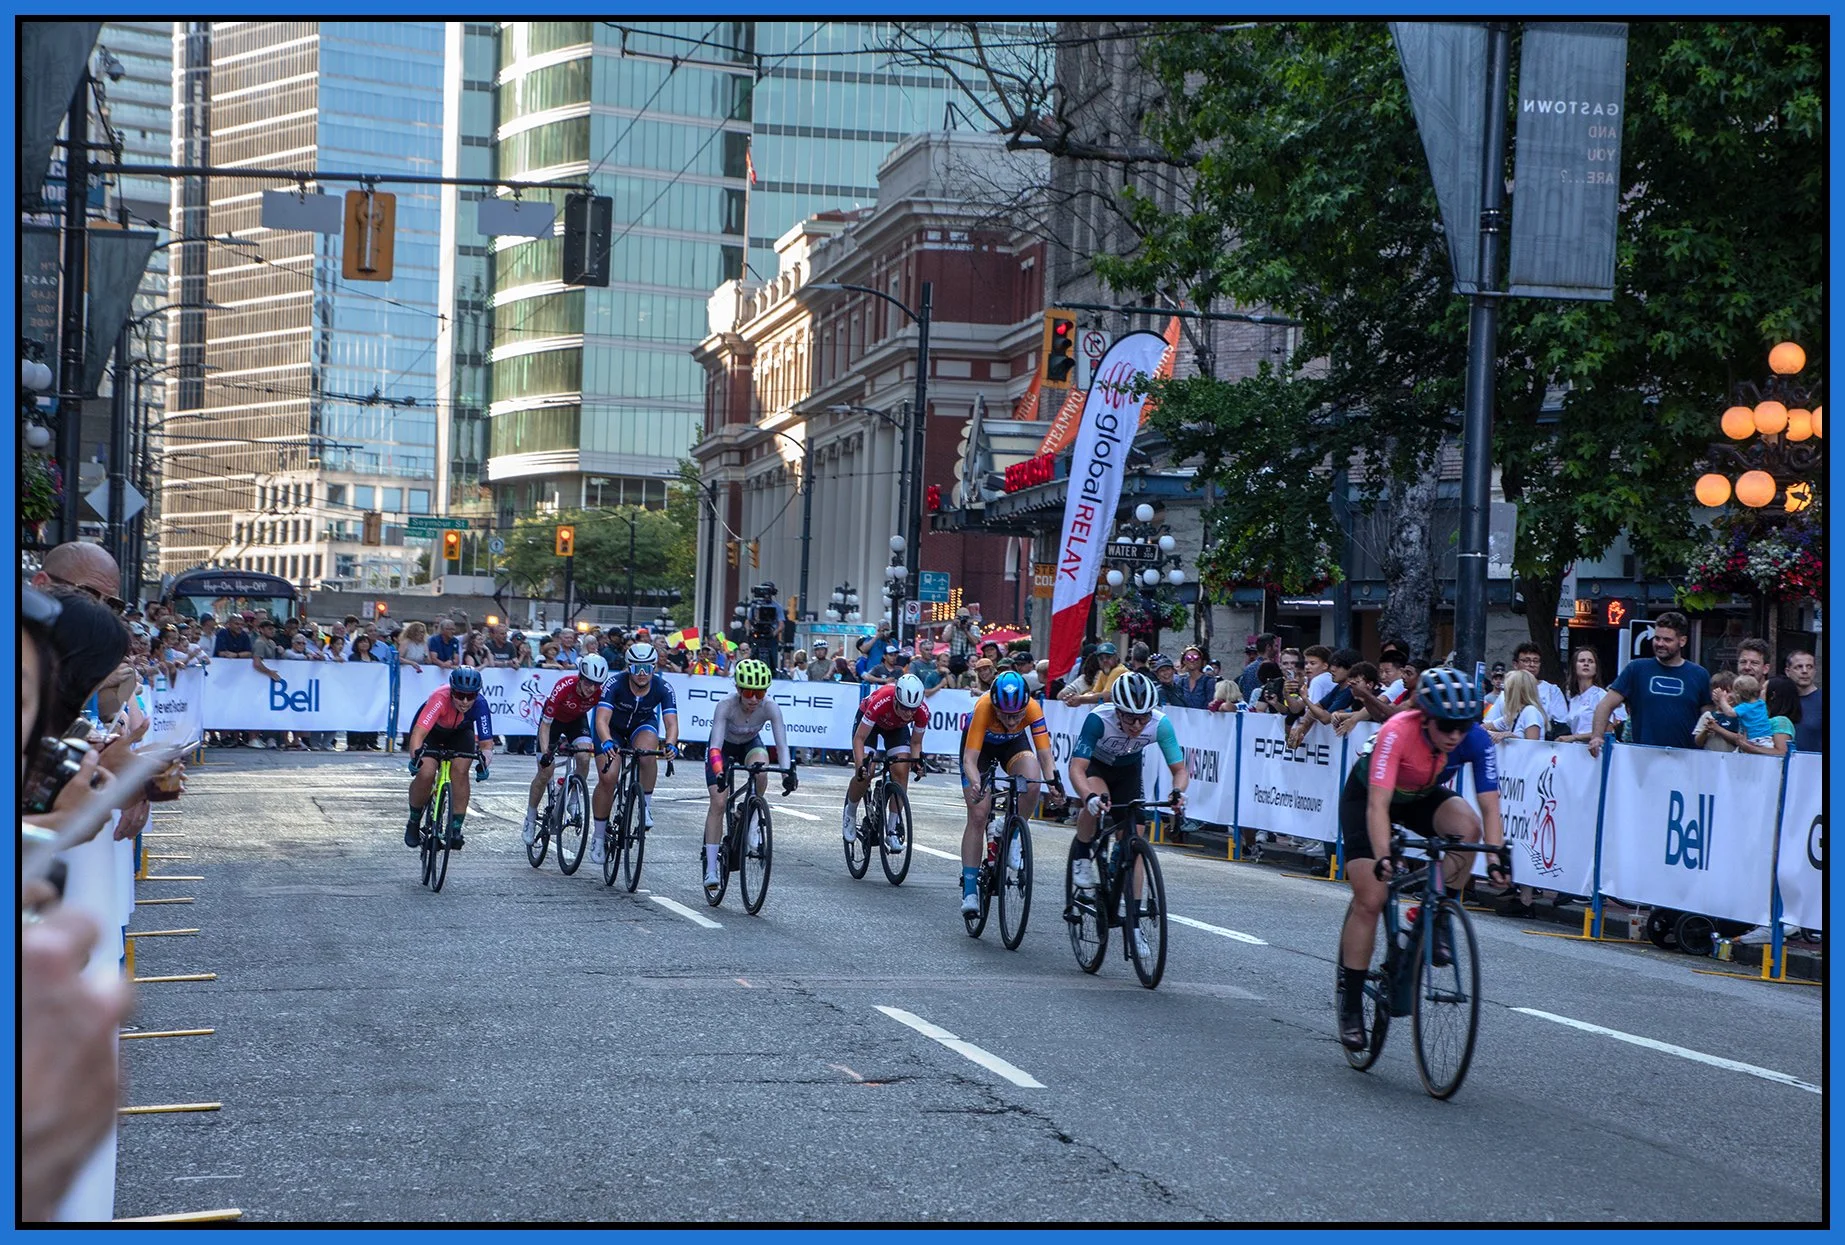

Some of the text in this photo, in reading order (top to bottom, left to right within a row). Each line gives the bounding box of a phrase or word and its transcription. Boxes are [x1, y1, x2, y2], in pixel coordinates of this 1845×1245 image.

[1041, 389, 1087, 456] STEAMWO
[412, 519, 451, 528] Seymour
[1107, 545, 1138, 557] WATER
[269, 678, 320, 713] Bell
[549, 678, 574, 703] MOSAIC
[688, 688, 834, 709] POCHE
[1254, 737, 1330, 766] PORSCHE
[1665, 790, 1714, 871] Bell
